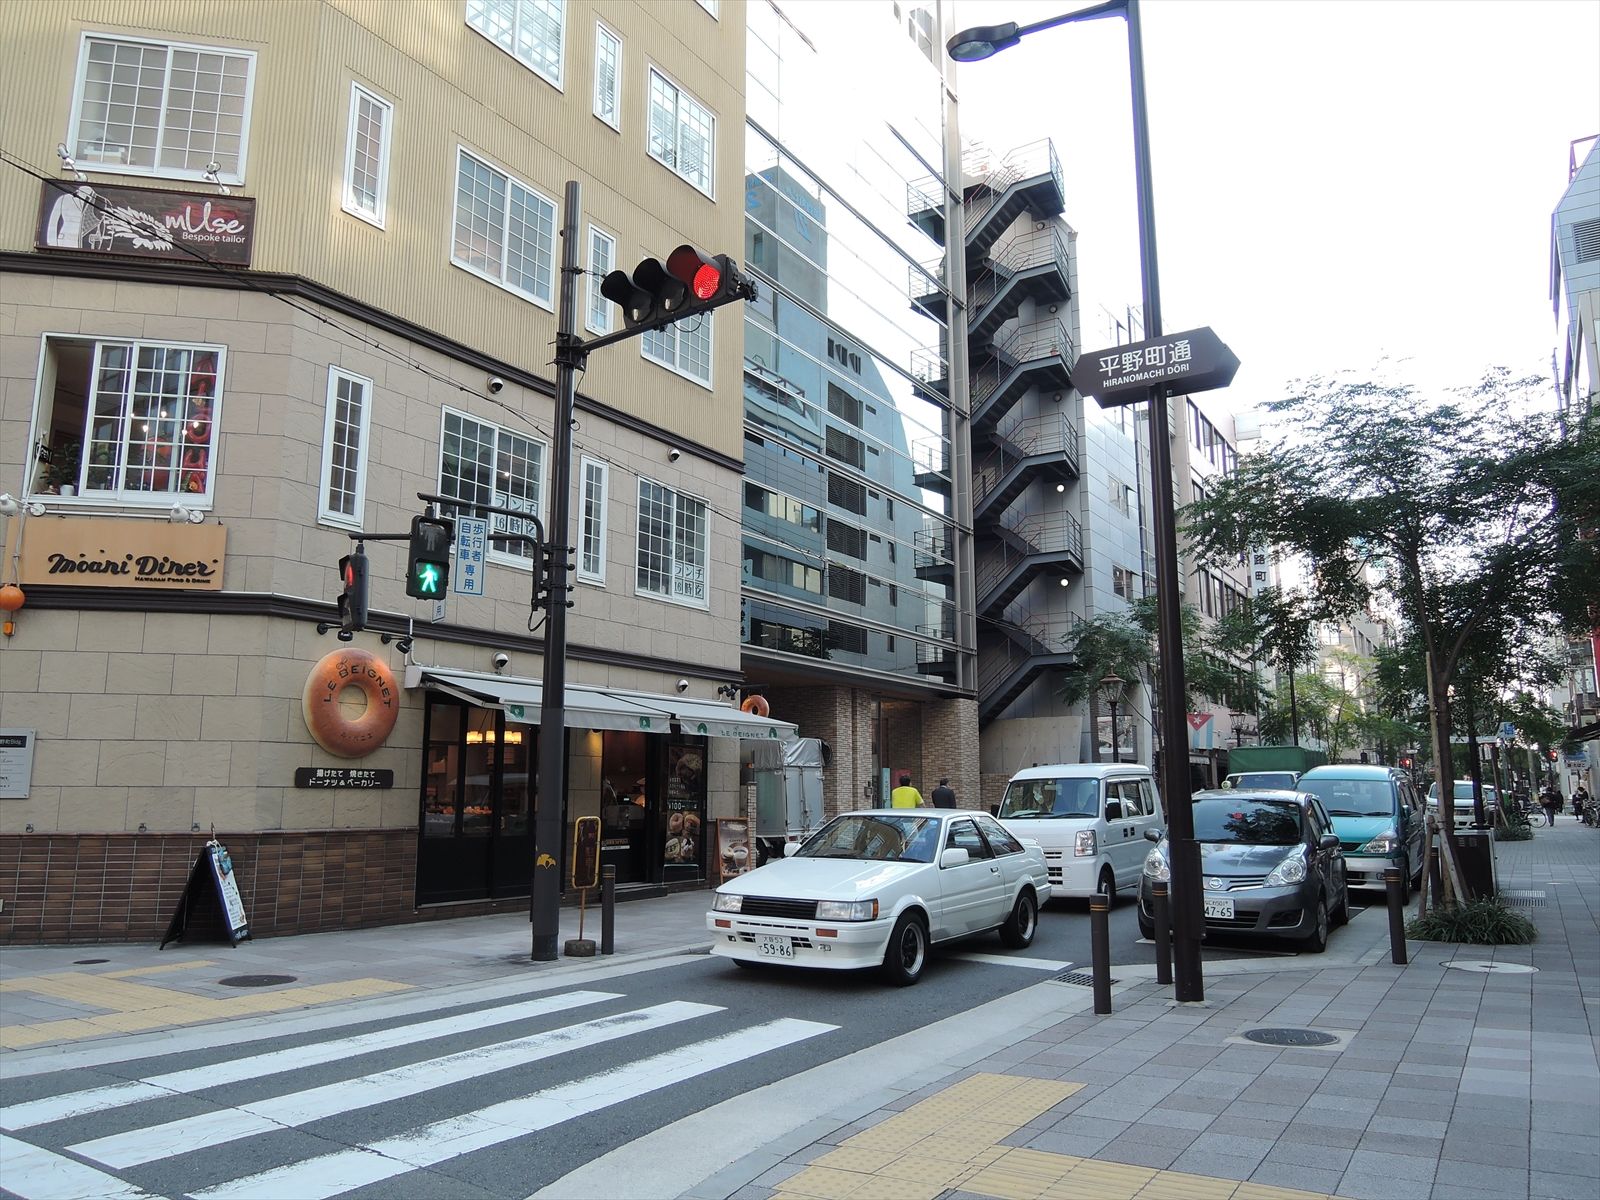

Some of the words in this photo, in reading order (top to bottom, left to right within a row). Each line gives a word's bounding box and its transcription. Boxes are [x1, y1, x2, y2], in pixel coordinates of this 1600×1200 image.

[182, 231, 220, 242] Bespoke
[222, 234, 246, 244] tailor
[1099, 340, 1192, 377] 平野町通
[1103, 369, 1164, 388] HIRANOMACHI
[460, 522, 471, 560] 自転車
[472, 523, 484, 562] 歩行者
[463, 564, 475, 590] 専用
[323, 680, 337, 703] LE
[338, 664, 392, 709] BEIGNET
[1205, 906, 1233, 917] 47-65
[763, 943, 791, 956] 59-86
